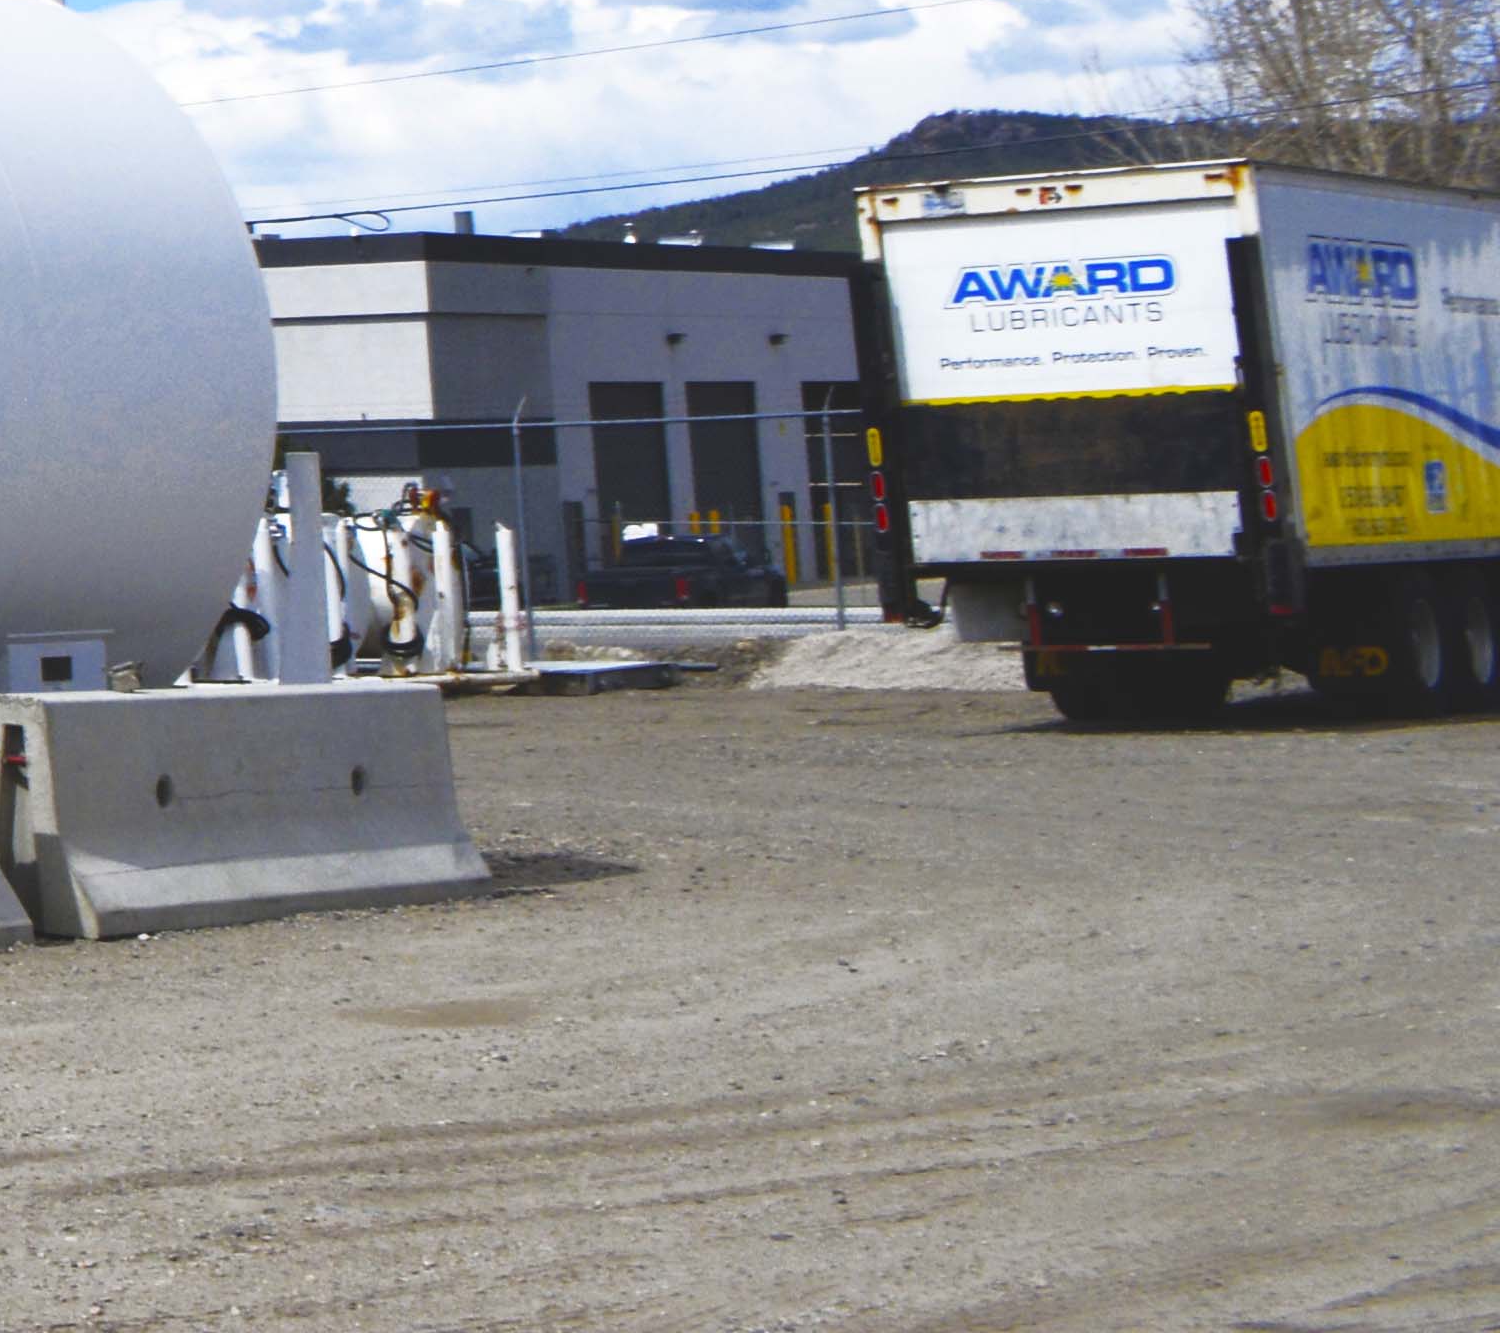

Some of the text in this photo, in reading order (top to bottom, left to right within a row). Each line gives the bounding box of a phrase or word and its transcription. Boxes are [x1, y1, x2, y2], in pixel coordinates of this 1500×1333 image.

[952, 258, 1175, 304] AWARD
[970, 301, 1164, 333] LUBRICANTS
[1147, 344, 1207, 360] Proven.
